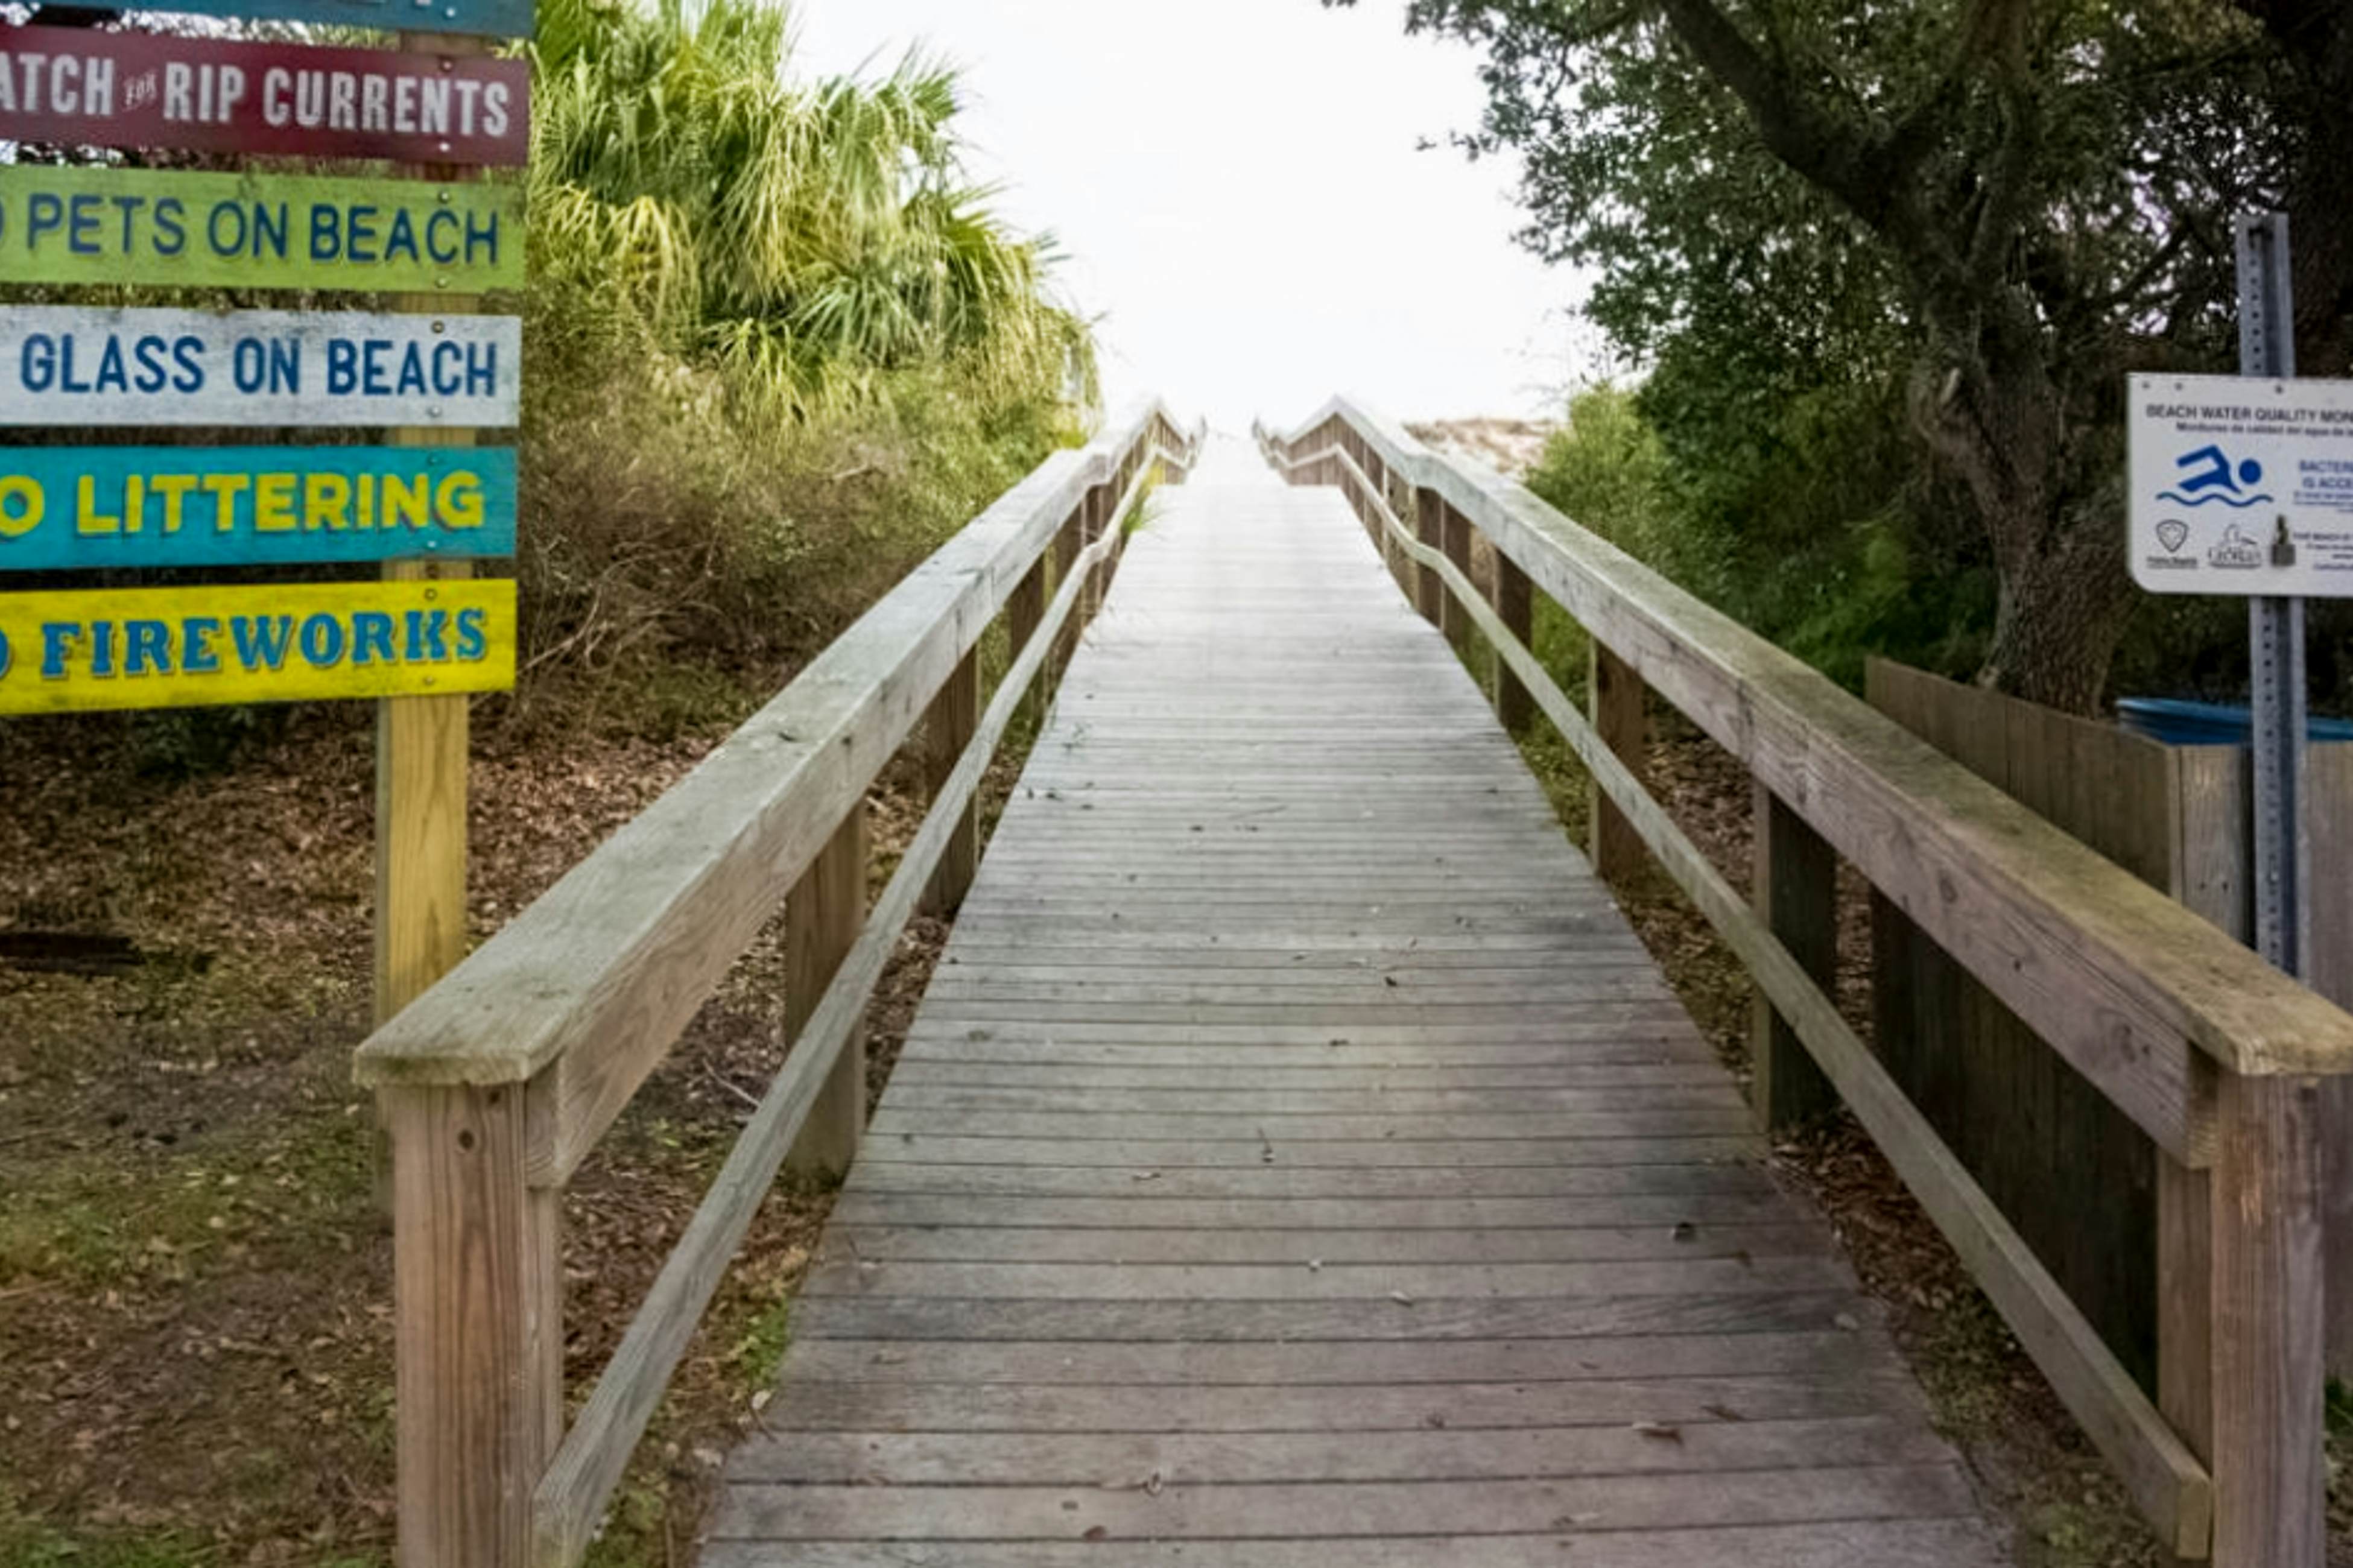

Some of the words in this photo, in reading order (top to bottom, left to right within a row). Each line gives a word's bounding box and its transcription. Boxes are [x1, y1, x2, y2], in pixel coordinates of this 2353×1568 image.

[163, 62, 244, 122] RIP
[264, 67, 510, 138] CURRENTS
[27, 192, 186, 256] PETS
[207, 200, 289, 259] ON
[309, 203, 499, 264] BEACH
[21, 334, 206, 394] GLASS
[233, 338, 300, 395] ON
[326, 339, 497, 397] BEACH
[2146, 405, 2197, 420] BEACH
[2200, 406, 2251, 421] WATER
[2255, 407, 2316, 422] QUALITY
[77, 470, 484, 534] LITTERING
[41, 607, 486, 678] FIREWORKS
